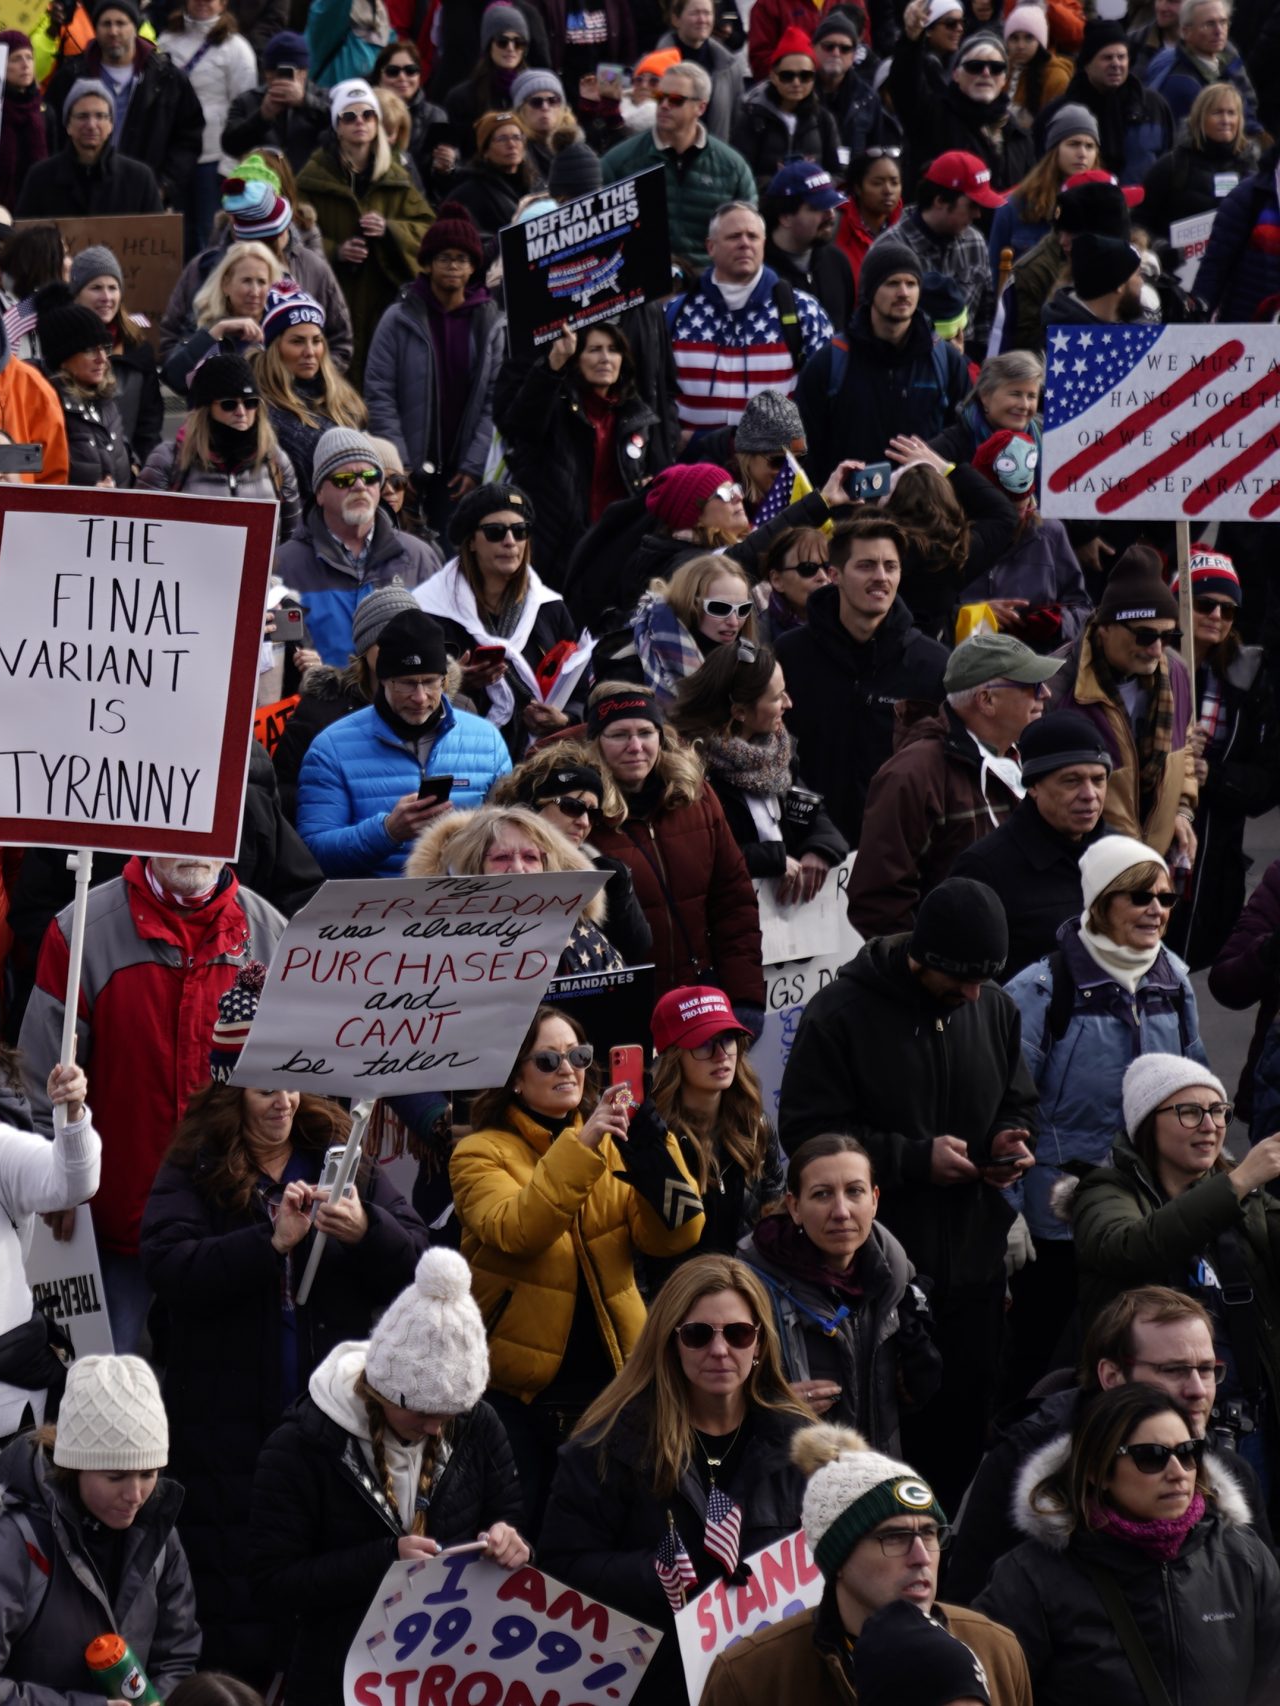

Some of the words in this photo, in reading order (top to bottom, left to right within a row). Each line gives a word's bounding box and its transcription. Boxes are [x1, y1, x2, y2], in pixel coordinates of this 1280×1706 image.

[525, 199, 595, 241] DEFEAT
[598, 180, 637, 209] THE
[527, 201, 639, 262] MANDATES
[1147, 355, 1178, 372] WE
[1190, 355, 1256, 373] MUST
[1111, 391, 1171, 409] HANG
[1078, 431, 1105, 447] OR
[1120, 431, 1153, 448] WE
[1171, 431, 1249, 449] SHALL
[1067, 476, 1130, 494] HANG
[1147, 476, 1280, 496] SEPARATE
[78, 518, 165, 566] THE
[52, 573, 200, 636] FINAL
[1115, 608, 1157, 620] LEHIGH
[88, 698, 127, 735] IS
[351, 893, 584, 920] FREEDOM
[318, 923, 387, 940] was
[402, 915, 542, 948] already
[280, 946, 548, 986] PURCHASED
[560, 972, 635, 993] MANDATES
[363, 985, 459, 1011] and
[679, 998, 700, 1011] MAKE
[334, 1010, 462, 1048] CAN'T
[272, 1050, 335, 1076] be
[353, 1050, 480, 1079] taken
[423, 1552, 482, 1605] I
[497, 1567, 610, 1643] AM
[393, 1606, 628, 1699] 99.99%
[354, 1664, 593, 1706] STRON
